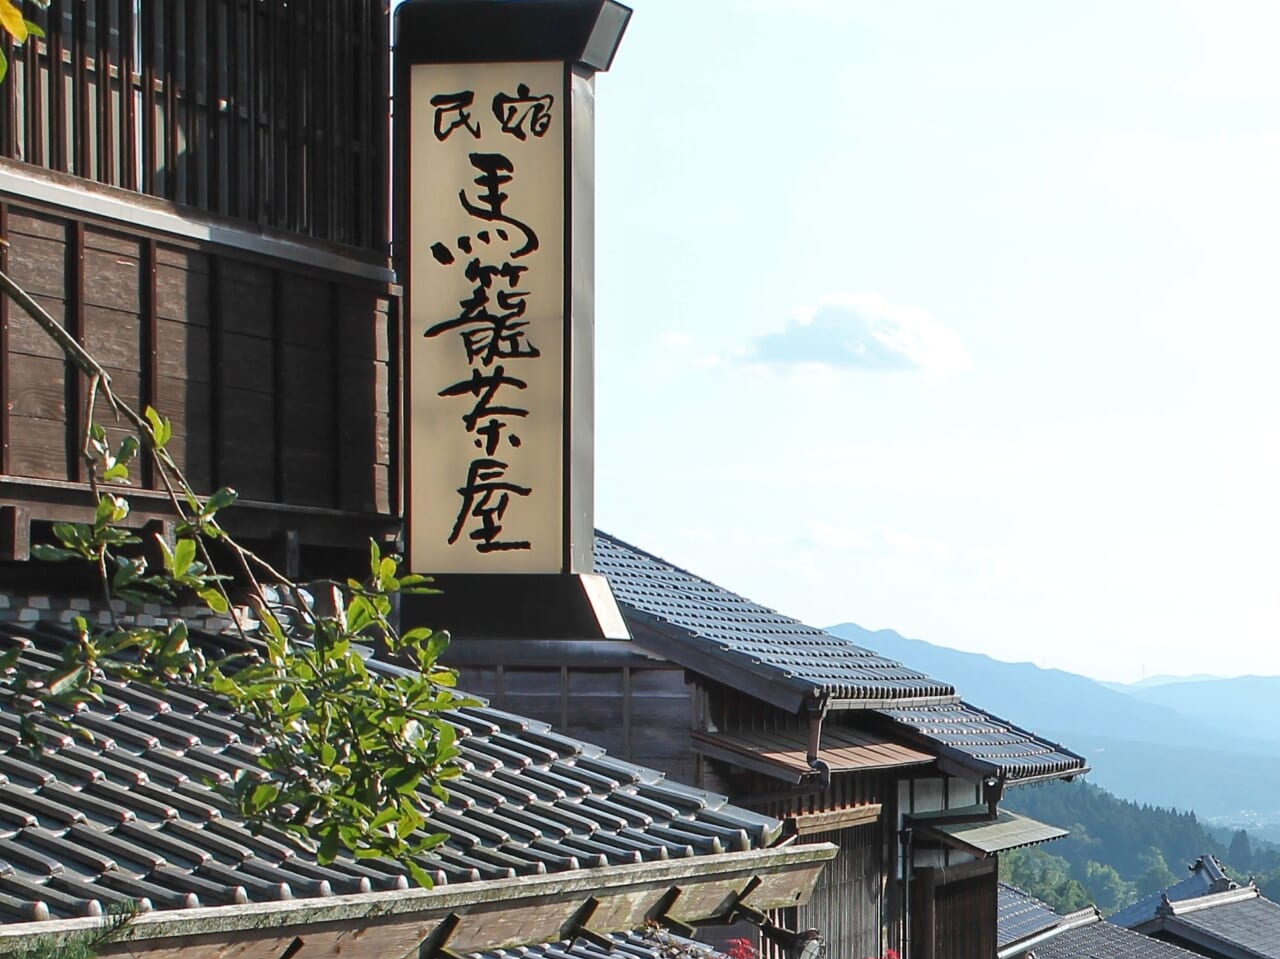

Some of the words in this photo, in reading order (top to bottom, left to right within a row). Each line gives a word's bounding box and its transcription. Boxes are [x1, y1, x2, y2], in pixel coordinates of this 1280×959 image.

[429, 83, 555, 142] 民宿
[423, 152, 540, 553] 馬籠茶屋
